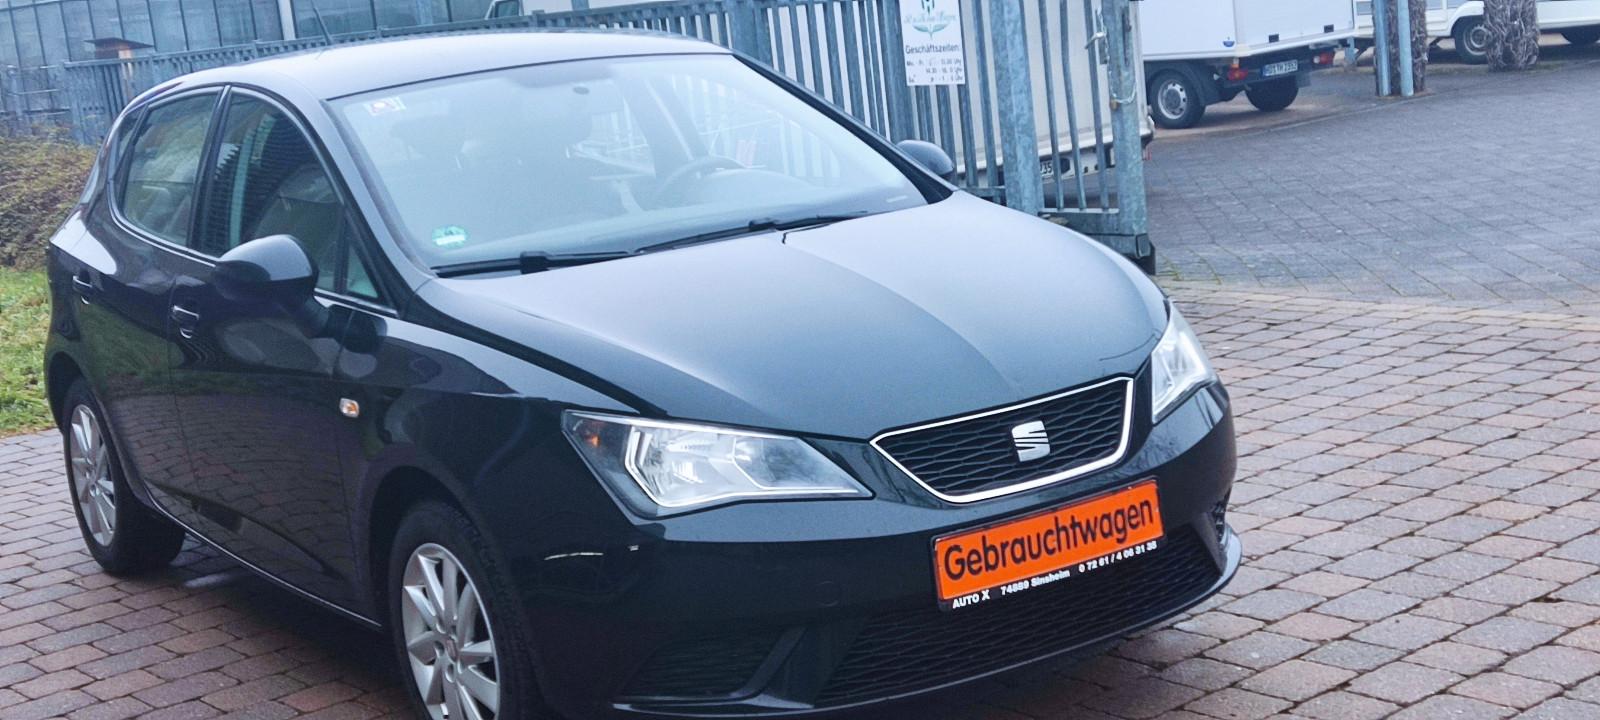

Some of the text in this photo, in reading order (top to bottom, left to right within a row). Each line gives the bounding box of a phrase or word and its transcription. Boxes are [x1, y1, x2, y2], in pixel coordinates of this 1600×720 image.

[944, 499, 1154, 581] Gebrauchtwagen
[952, 593, 980, 609] AUTO
[981, 589, 990, 601] X
[1031, 570, 1070, 587] Sinsheim
